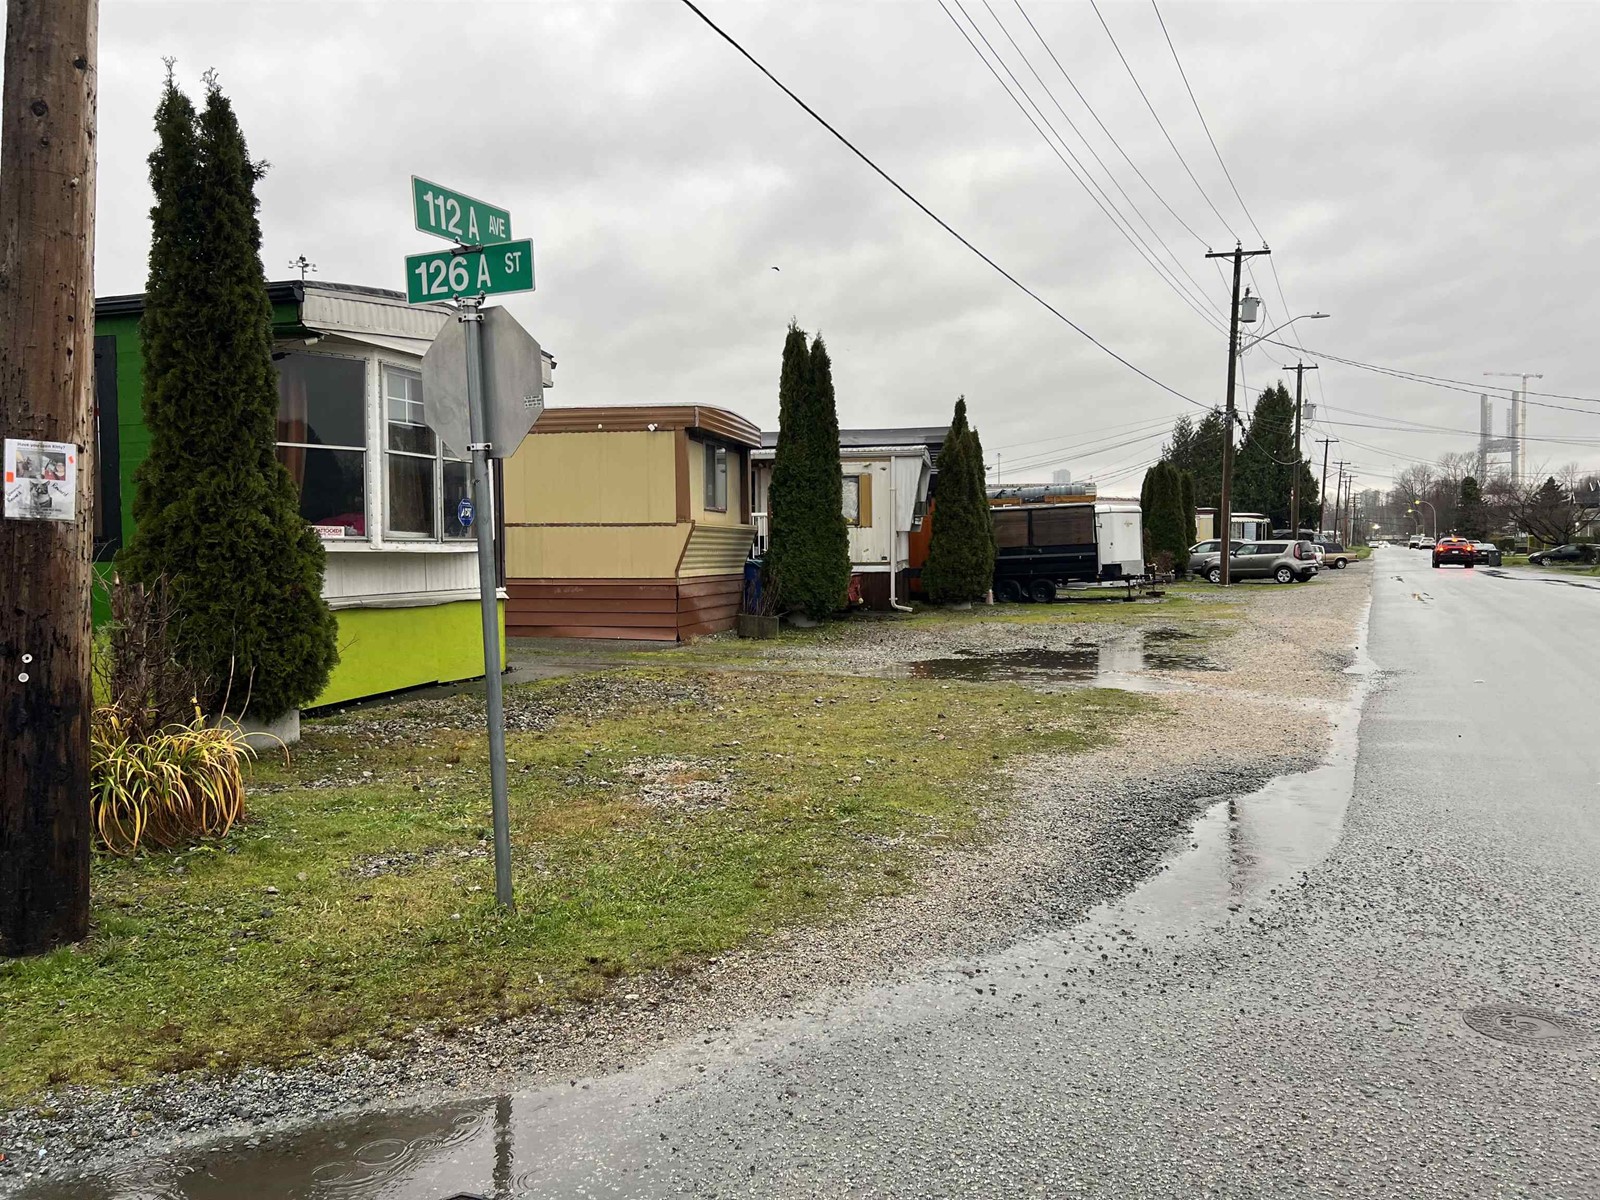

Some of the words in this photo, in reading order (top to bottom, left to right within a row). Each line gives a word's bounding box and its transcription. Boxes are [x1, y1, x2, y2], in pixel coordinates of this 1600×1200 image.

[423, 190, 463, 236] 112
[468, 206, 480, 241] A
[488, 215, 506, 238] AVE
[415, 256, 470, 296] 126
[476, 254, 492, 289] A
[504, 251, 522, 274] ST
